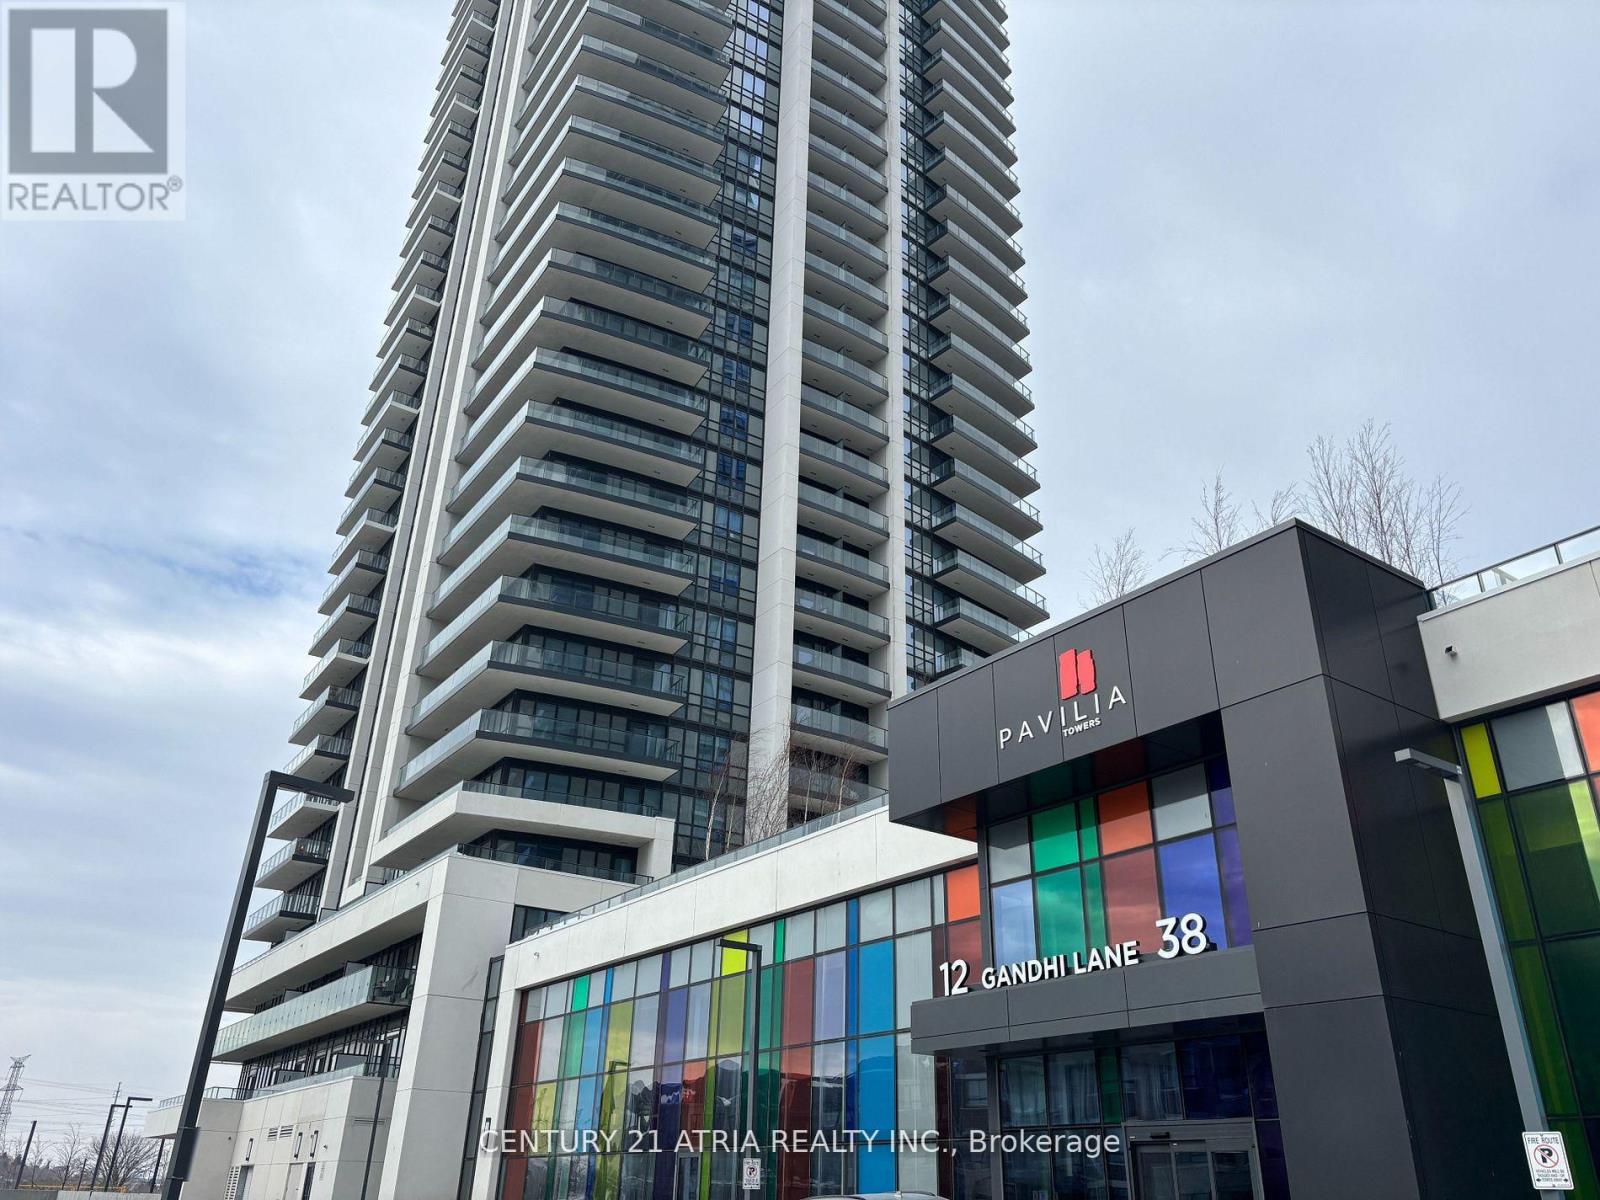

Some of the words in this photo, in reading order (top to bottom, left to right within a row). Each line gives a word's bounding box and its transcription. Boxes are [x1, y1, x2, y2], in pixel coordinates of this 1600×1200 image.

[1000, 685, 1126, 749] PAVILIA
[1062, 717, 1101, 737] TOWERS
[939, 959, 969, 997] 12
[981, 954, 1066, 989] GANDHI
[1073, 940, 1139, 975] LANE
[1155, 913, 1208, 959] 38
